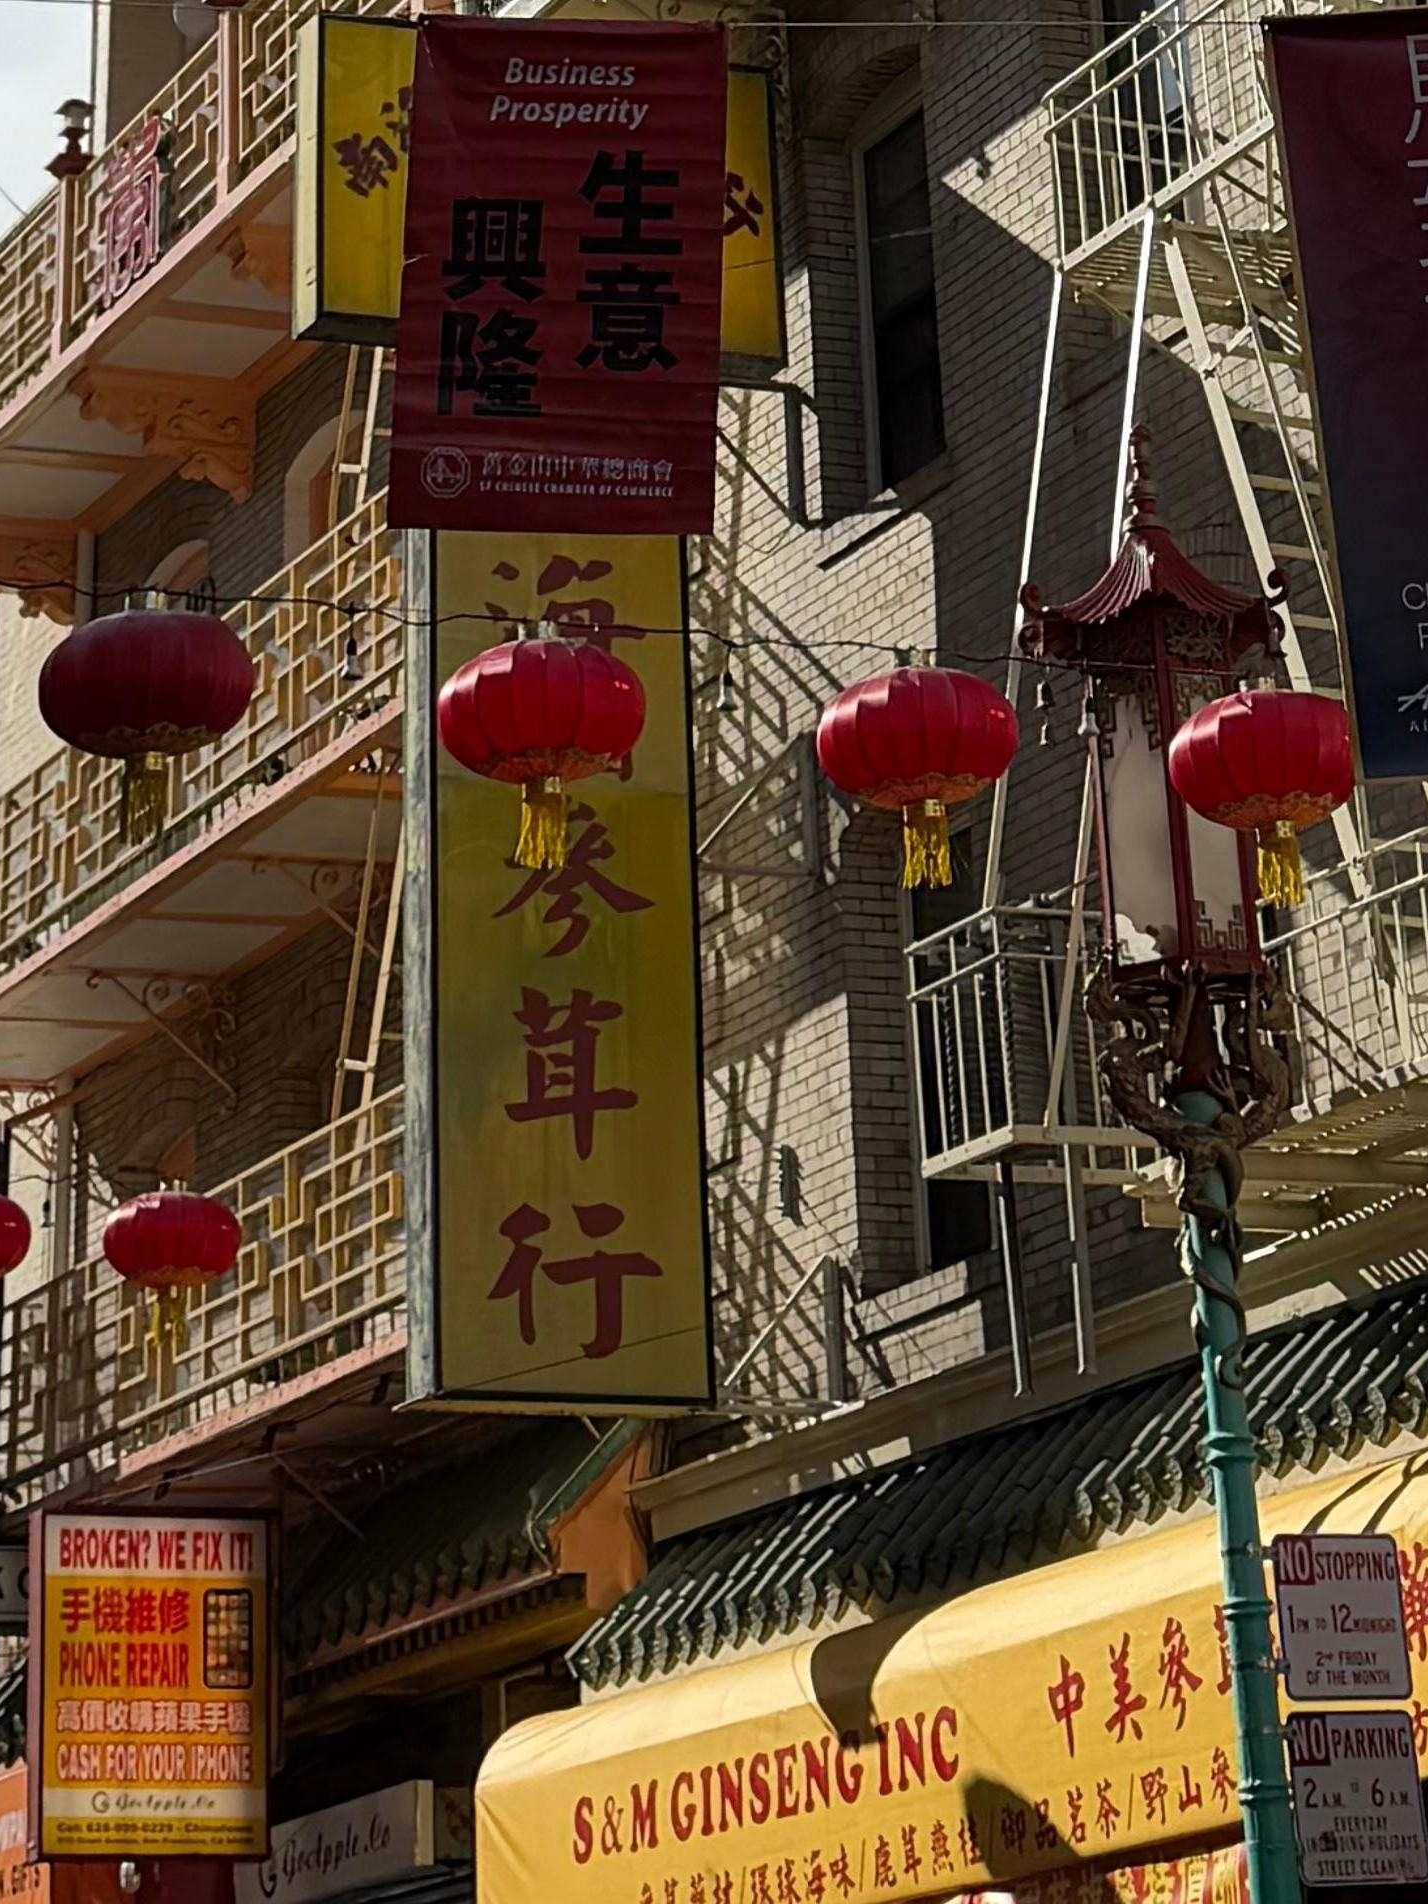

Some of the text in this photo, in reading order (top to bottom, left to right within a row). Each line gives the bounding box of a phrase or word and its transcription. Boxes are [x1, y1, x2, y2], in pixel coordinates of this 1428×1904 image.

[503, 57, 637, 88] Business
[489, 93, 650, 131] Prosperity
[58, 1528, 254, 1572] BROKEN? WE FIX IT!
[1279, 1540, 1396, 1583] NO STOPPING
[58, 1586, 191, 1635] 手機維修
[58, 1642, 191, 1688] PHONE REPAIR
[1327, 1670, 1348, 1686] THE
[1352, 1669, 1392, 1686] MONTH
[1292, 1718, 1410, 1762] NO PARKING
[57, 1743, 252, 1783] CASH FOR YOUR IPHONE
[672, 1727, 864, 1843] GINSENG
[876, 1703, 960, 1796] INC
[1302, 1777, 1319, 1809] 2
[1371, 1777, 1386, 1808] 6
[1304, 1832, 1365, 1854] INDING
[1333, 1815, 1389, 1834] EVERYDAY
[1316, 1857, 1416, 1878] STREET CLEAN
